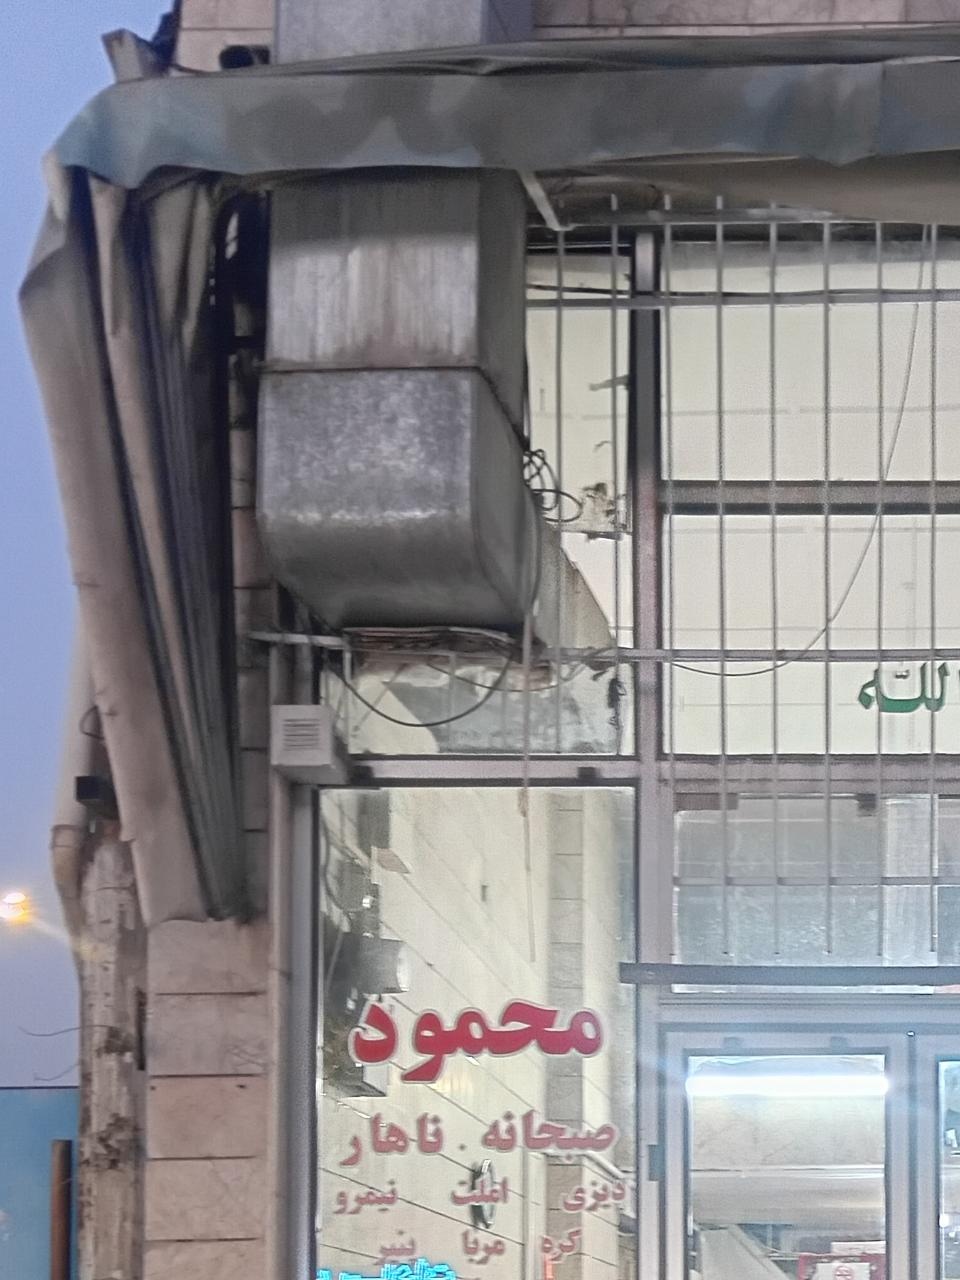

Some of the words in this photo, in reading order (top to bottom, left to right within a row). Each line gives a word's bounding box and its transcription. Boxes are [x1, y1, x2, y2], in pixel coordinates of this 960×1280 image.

[352, 998, 603, 1083] محمود
[339, 1112, 443, 1167] ناهار
[482, 1110, 617, 1161] صبحانه
[333, 1178, 399, 1215] نیمرو
[451, 1177, 509, 1205] املت
[562, 1179, 626, 1212] دیزی
[461, 1230, 506, 1265] مربا
[540, 1228, 582, 1263] کره
